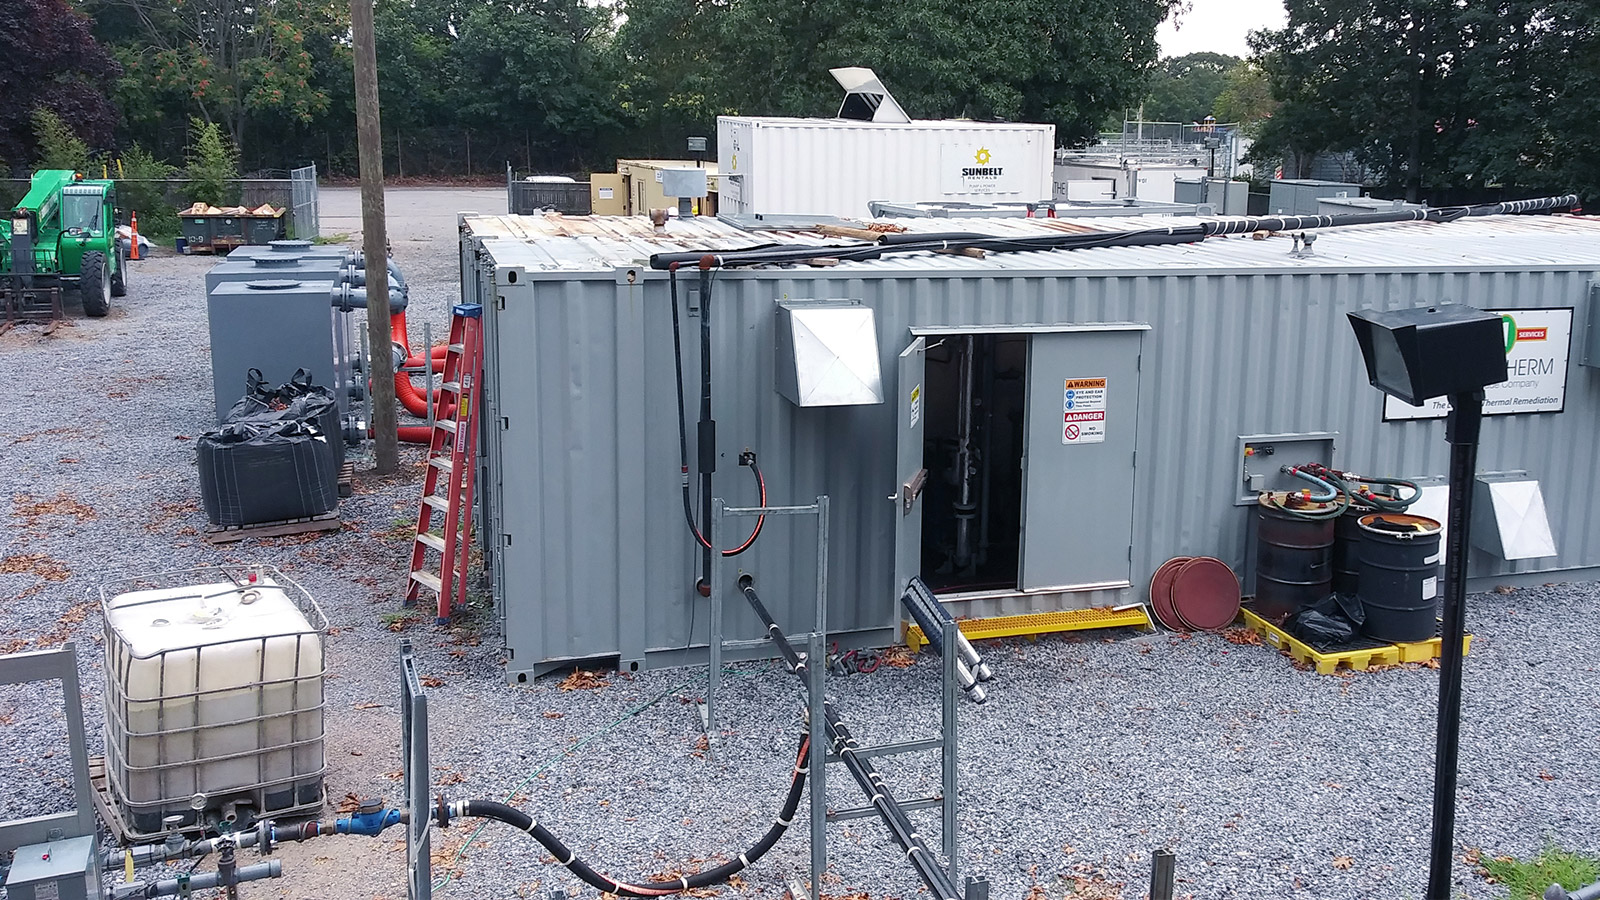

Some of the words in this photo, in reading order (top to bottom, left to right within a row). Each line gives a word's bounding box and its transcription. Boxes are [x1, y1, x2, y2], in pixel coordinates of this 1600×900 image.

[962, 168, 1003, 176] SUNBELT
[1506, 358, 1554, 376] HERM
[1501, 380, 1539, 389] Company
[1433, 401, 1446, 409] The
[1482, 398, 1512, 407] Thermal
[1513, 396, 1558, 405] Remediation
